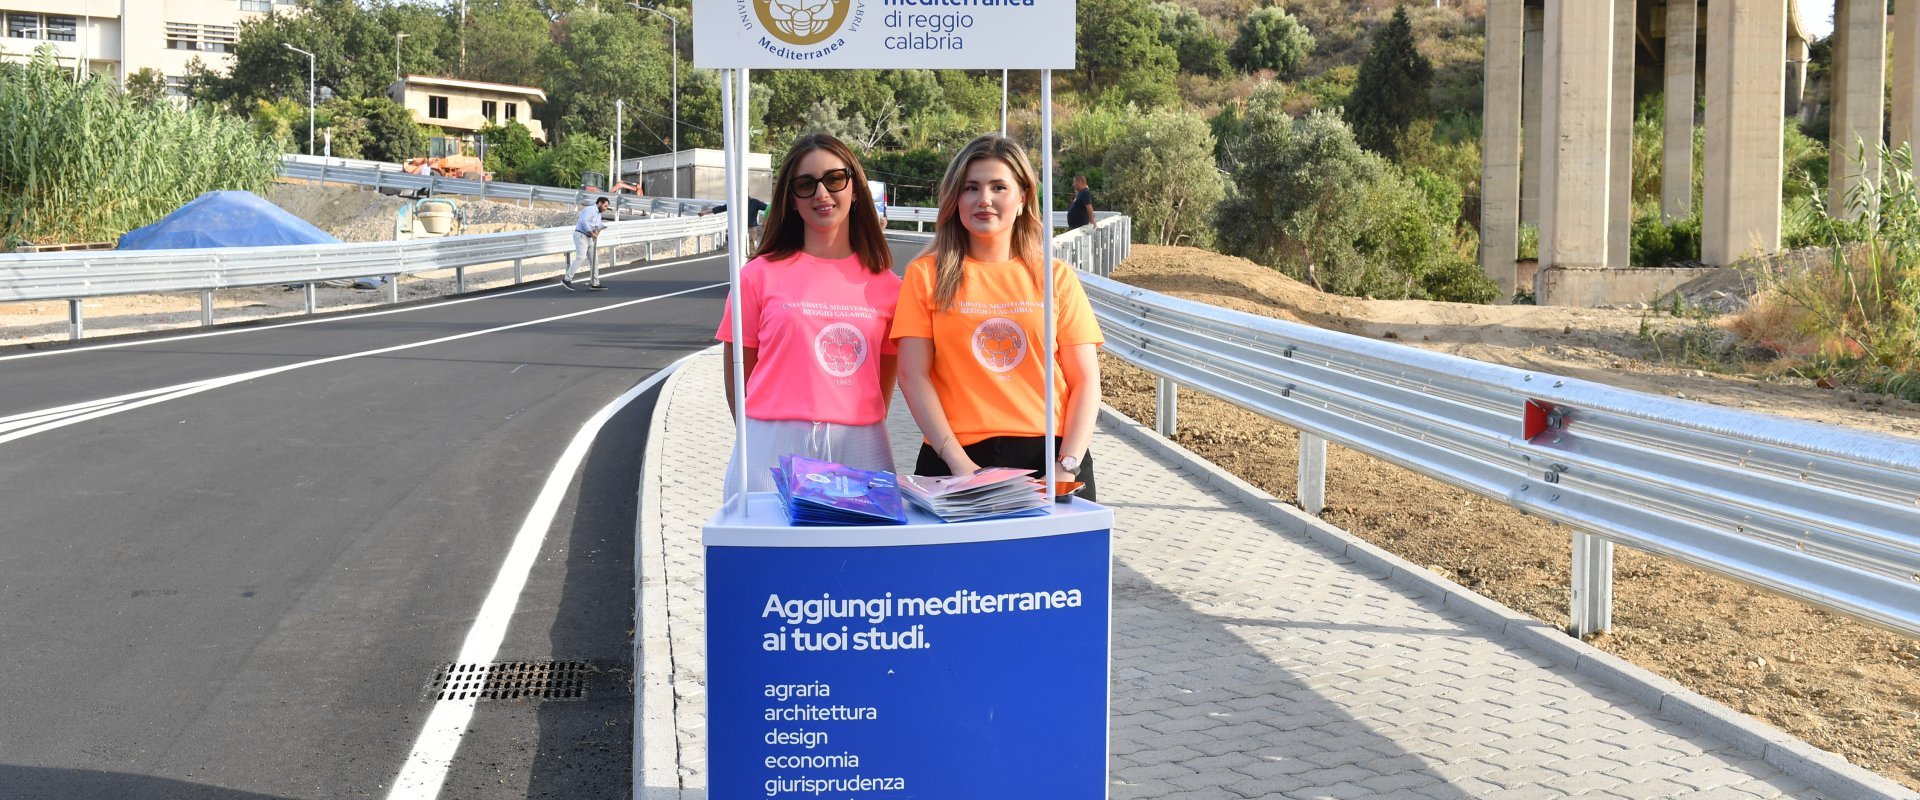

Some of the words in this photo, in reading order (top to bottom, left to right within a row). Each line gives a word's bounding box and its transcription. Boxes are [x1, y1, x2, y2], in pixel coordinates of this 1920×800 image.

[848, 0, 865, 32] ABRIA
[884, 9, 902, 28] di
[908, 11, 974, 33] reggio
[758, 36, 845, 60] Mediterranea
[884, 32, 963, 50] calabria
[762, 592, 892, 624] Aggiungi
[897, 588, 1082, 616] mediterranea
[762, 627, 786, 651] ai
[791, 626, 847, 651] tuoi
[853, 624, 931, 650] studi.
[764, 680, 830, 701] agraria
[764, 704, 877, 721] architettura
[764, 727, 828, 748] design
[764, 750, 860, 769] economia
[765, 775, 905, 797] giurisprudenza
